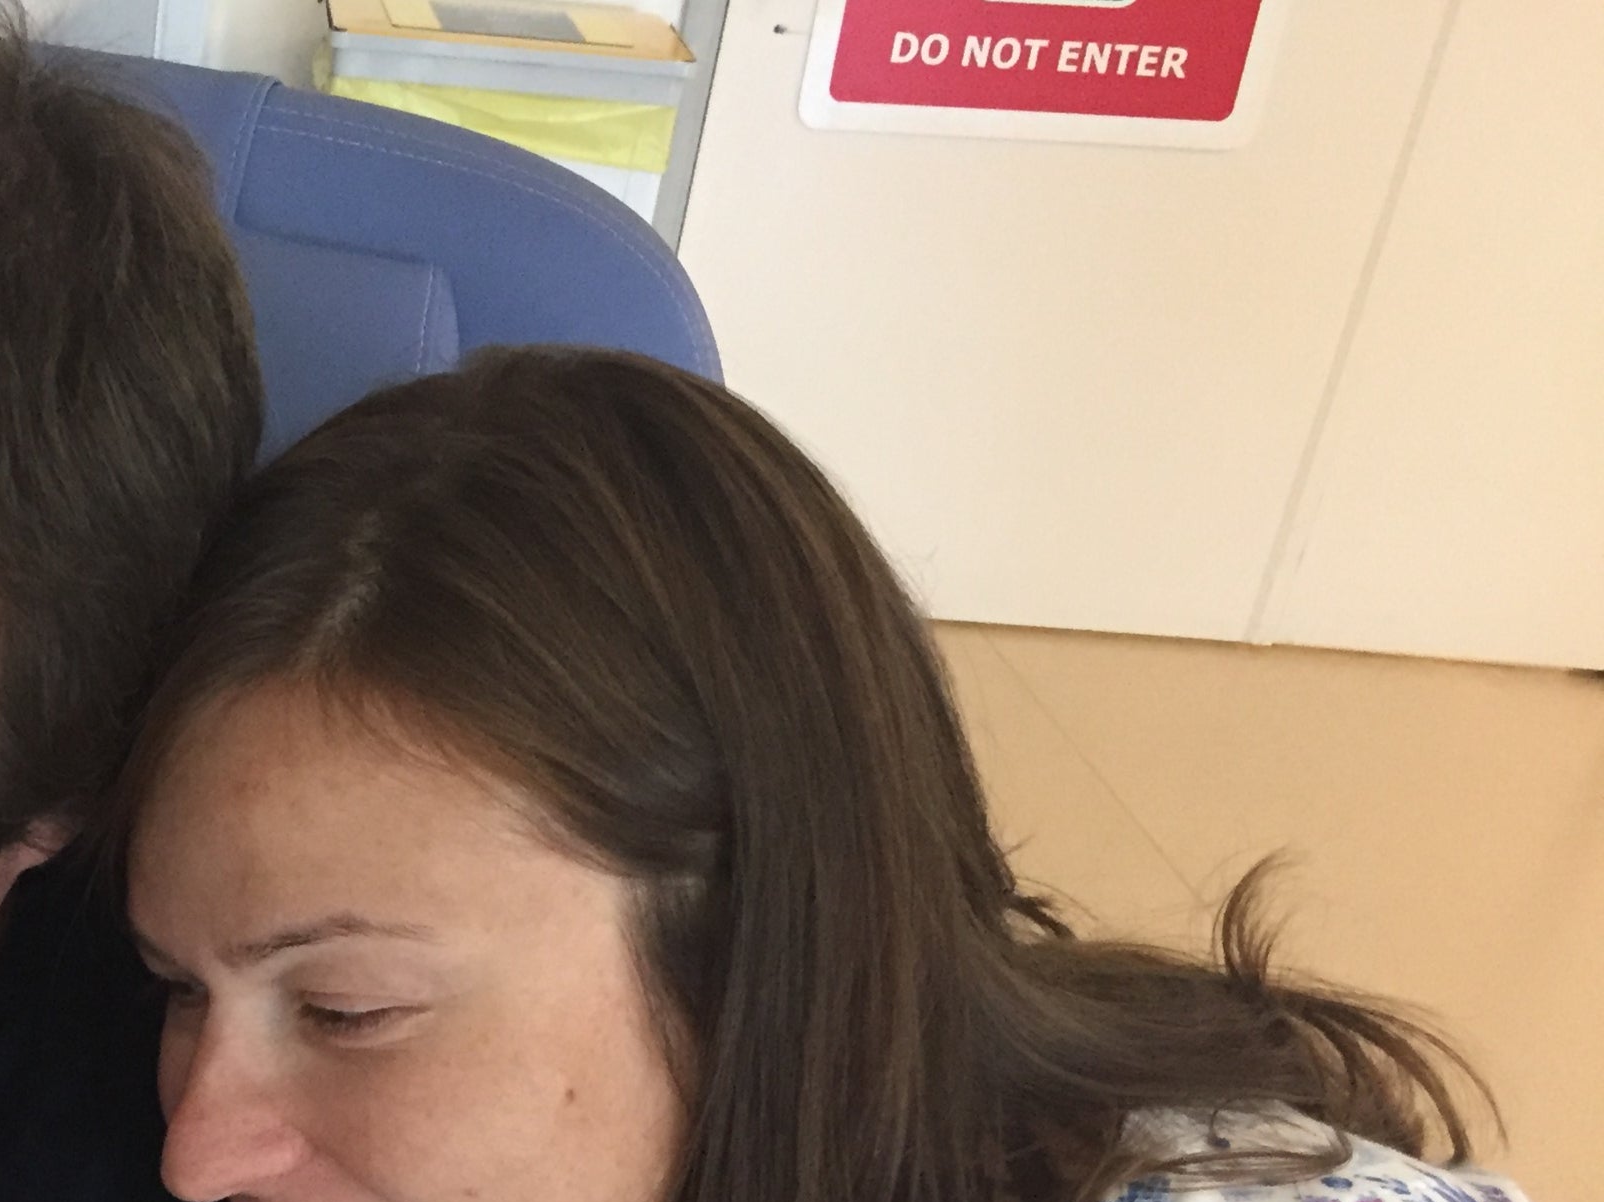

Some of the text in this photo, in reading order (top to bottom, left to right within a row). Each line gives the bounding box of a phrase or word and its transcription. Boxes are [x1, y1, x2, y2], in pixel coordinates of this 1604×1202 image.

[890, 31, 1189, 79] DO NOT ENTER
